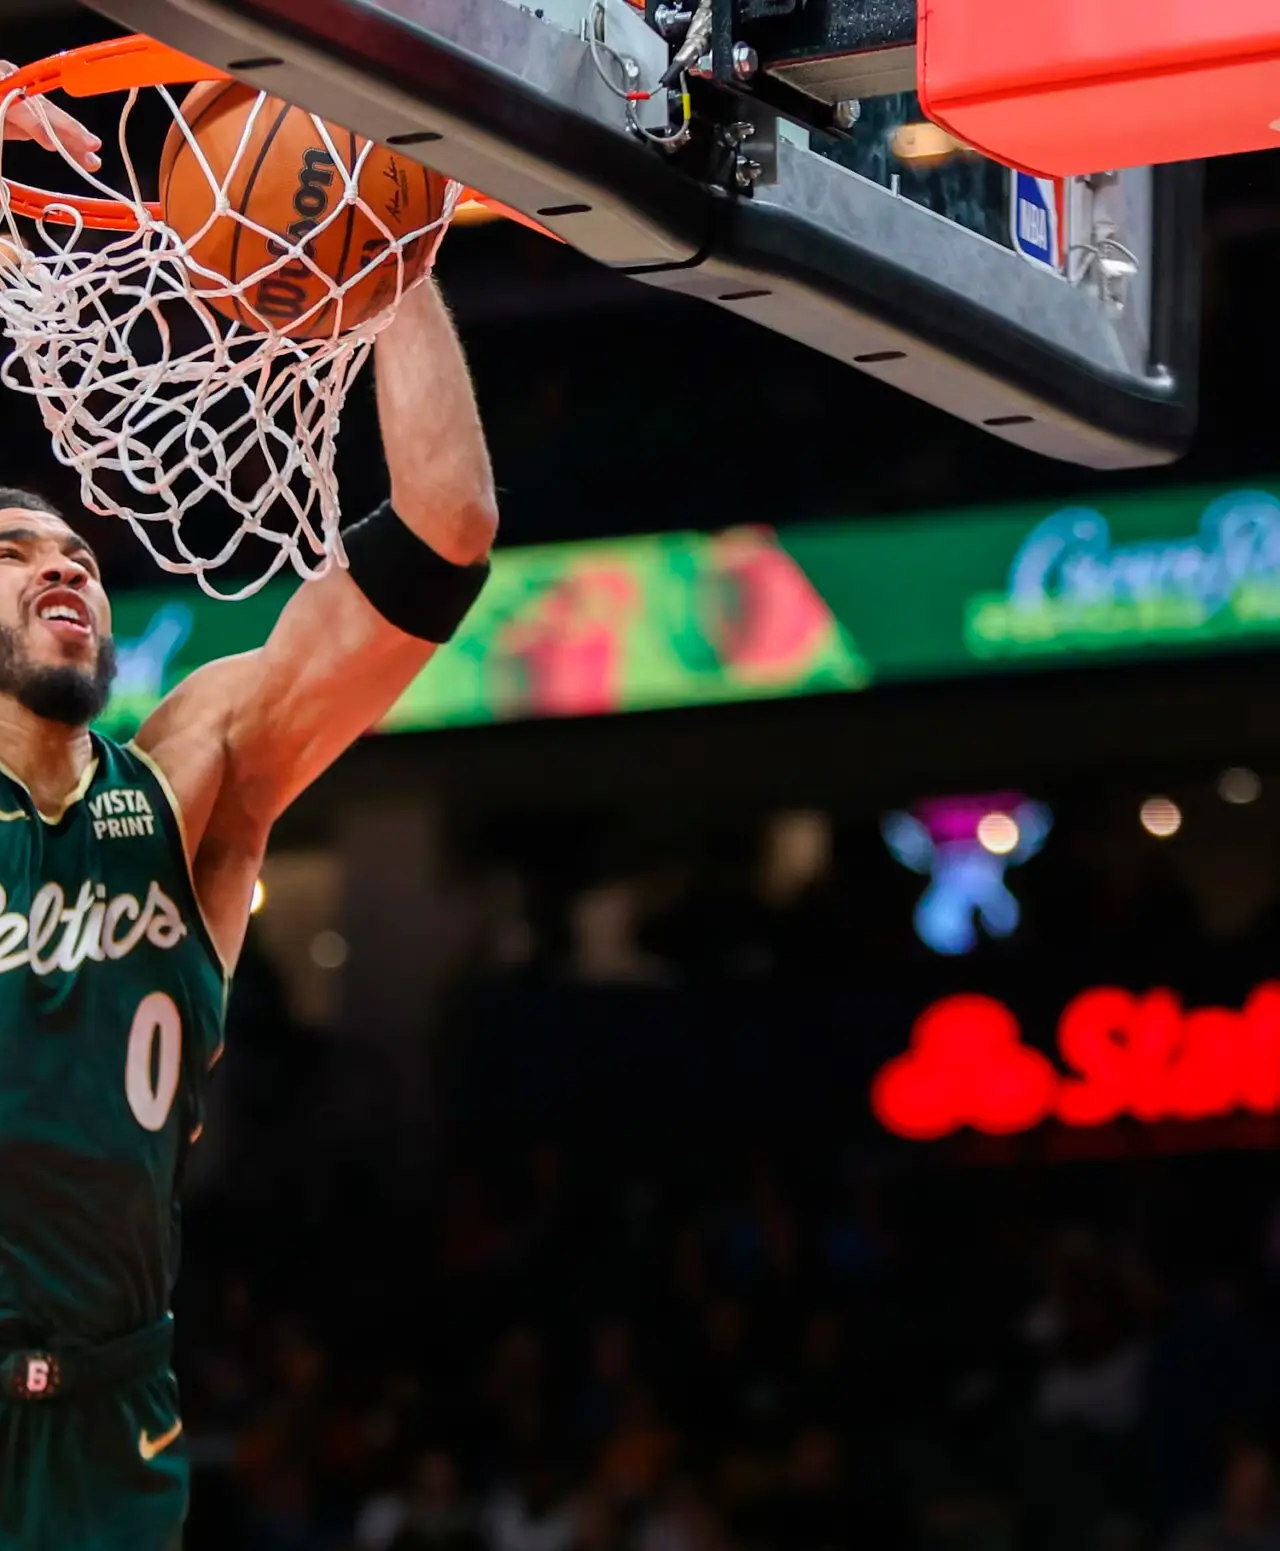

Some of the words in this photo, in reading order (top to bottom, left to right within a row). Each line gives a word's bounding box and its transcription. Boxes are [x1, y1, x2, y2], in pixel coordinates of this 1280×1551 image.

[1019, 197, 1048, 251] NBA
[88, 788, 153, 819] VISTA
[93, 814, 155, 840] PRINT
[124, 991, 183, 1132] 0
[26, 1359, 50, 1391] 6
